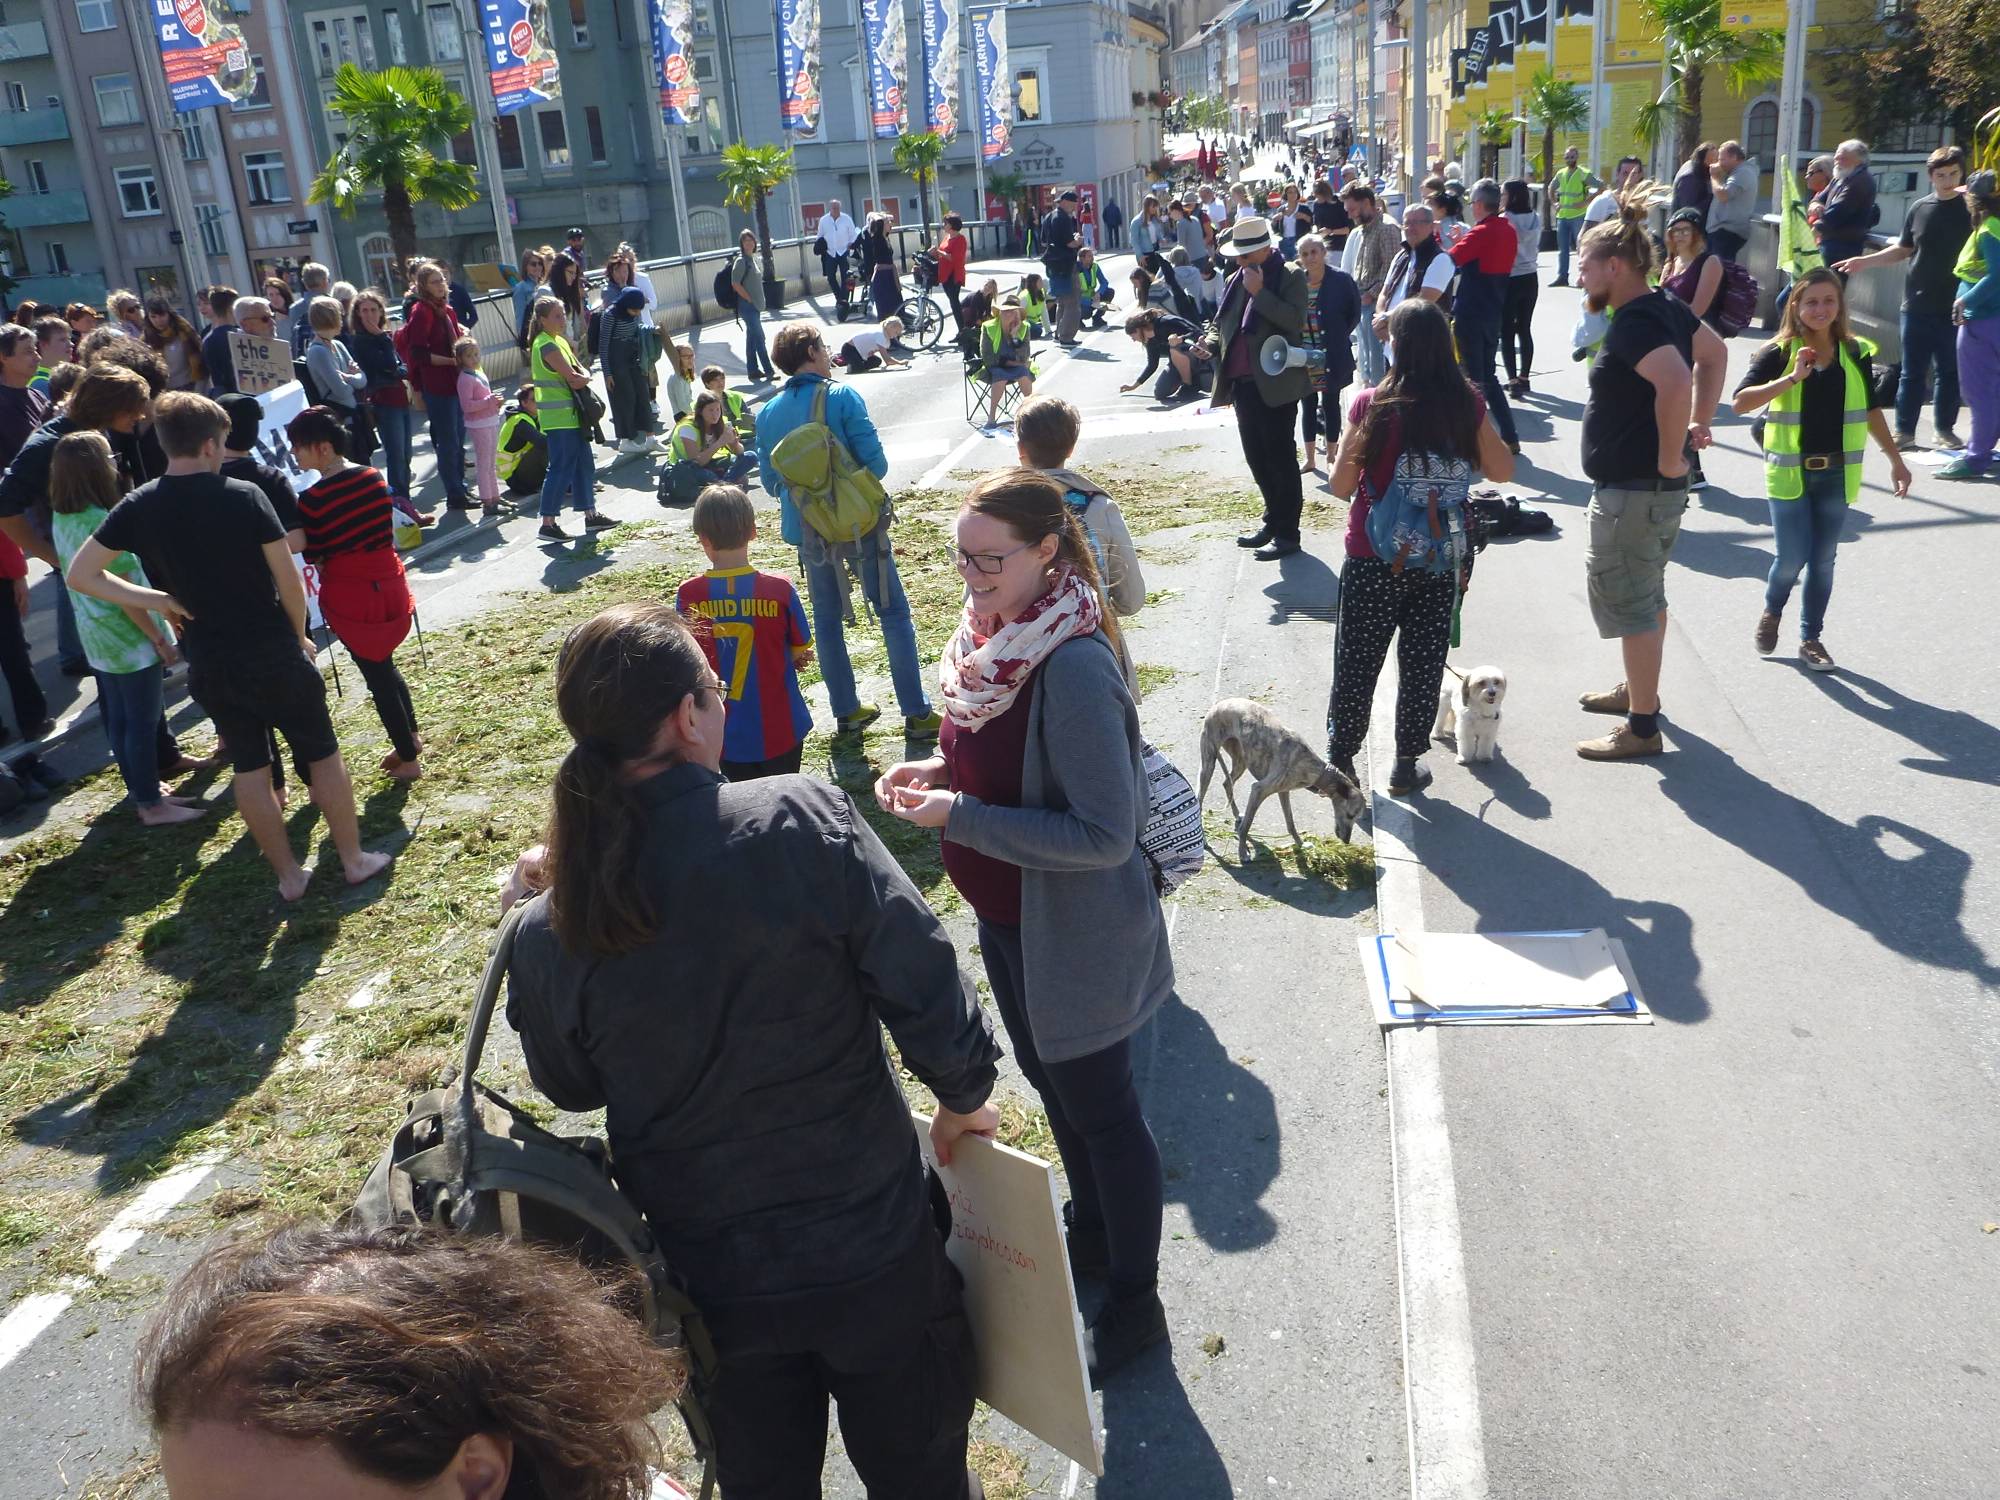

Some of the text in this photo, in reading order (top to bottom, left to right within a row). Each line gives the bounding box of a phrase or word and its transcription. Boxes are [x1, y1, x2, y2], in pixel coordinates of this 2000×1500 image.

[973, 22, 990, 76] KÄRNTEN
[1465, 30, 1489, 74] BIER
[873, 58, 886, 110] RELIEF
[1162, 79, 1171, 128] HOEL
[1013, 157, 1064, 172] STYLE
[236, 338, 270, 360] the
[741, 599, 779, 618] VILLA
[712, 622, 755, 701] 7
